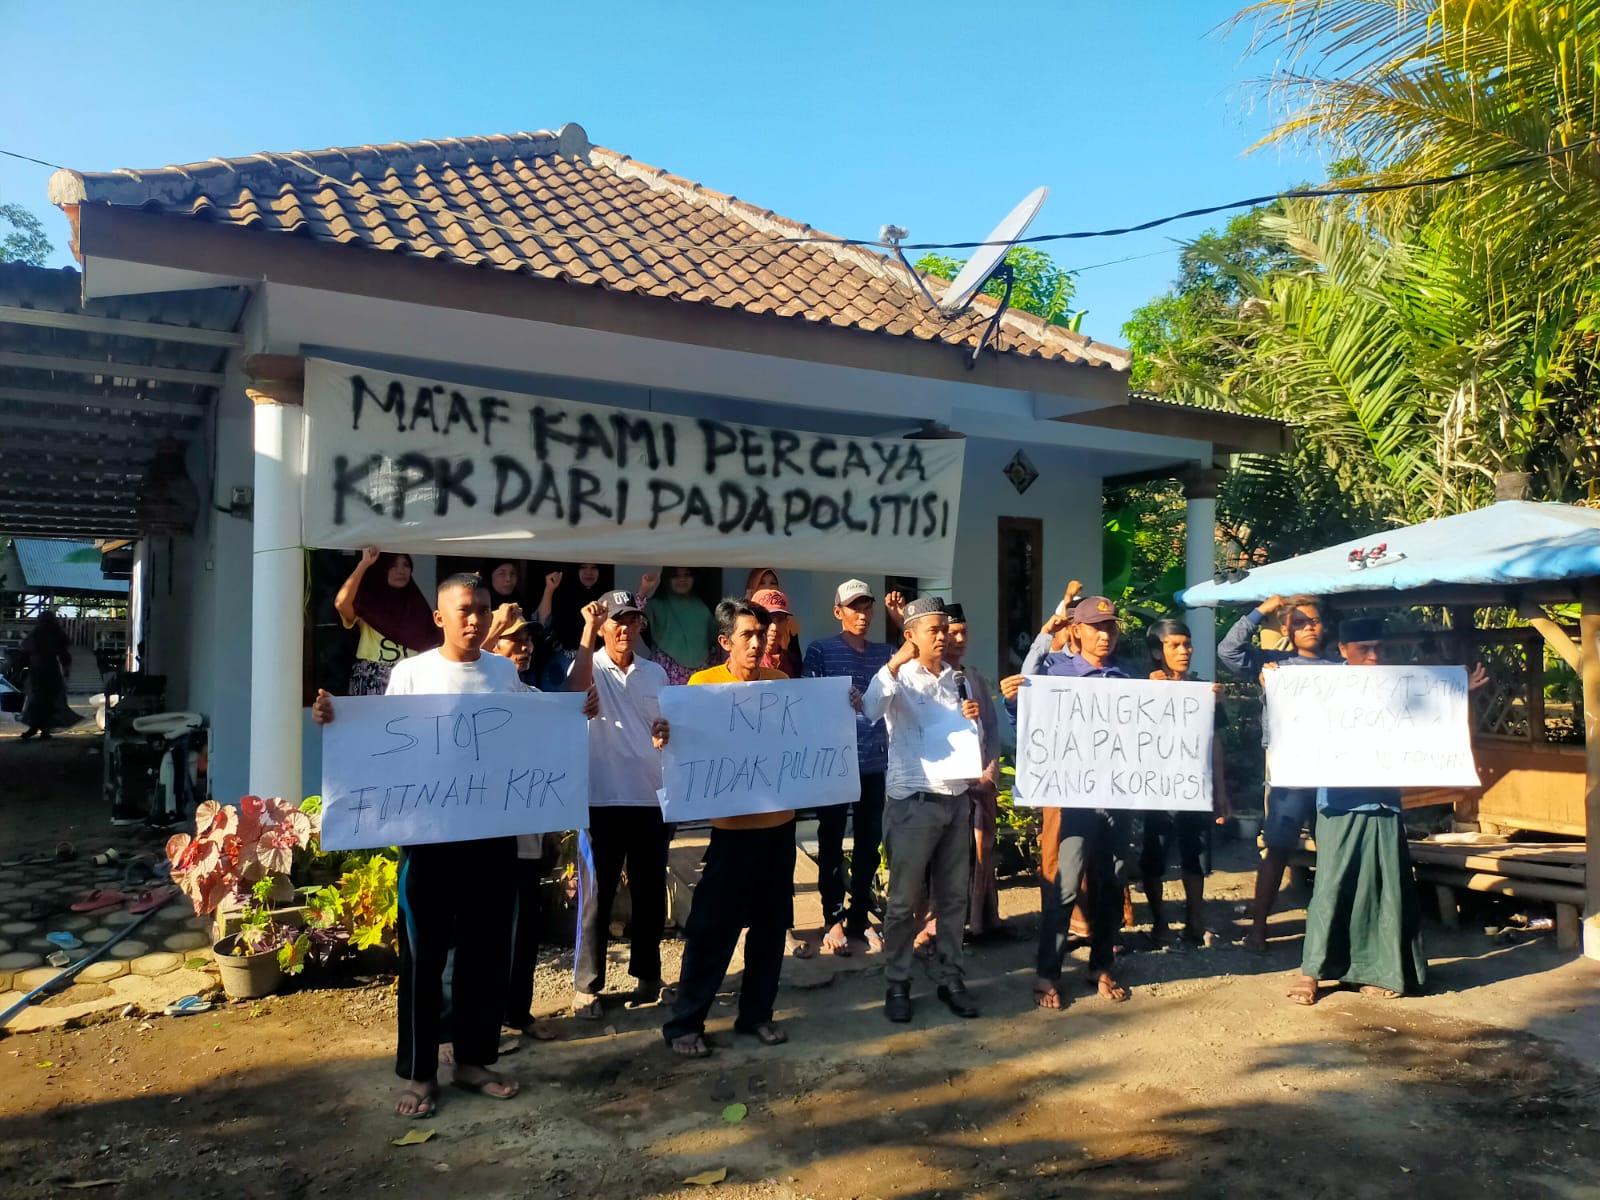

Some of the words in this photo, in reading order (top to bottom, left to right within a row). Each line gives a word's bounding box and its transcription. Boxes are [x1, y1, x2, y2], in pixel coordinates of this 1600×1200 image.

[349, 374, 509, 446] MAAF
[530, 405, 677, 469] KAMI
[697, 418, 926, 485] PERCAYA
[333, 452, 478, 526] KPK
[492, 454, 629, 526] DARI
[1050, 688, 1200, 728] TANGKAP
[1273, 674, 1414, 702] MASYRAKAT
[371, 707, 513, 761] STOP
[729, 692, 803, 736] KPK
[680, 756, 771, 801] TIDAK
[1030, 769, 1096, 798] YANG
[349, 771, 488, 835] FITNAH
[504, 768, 566, 811] KPK
